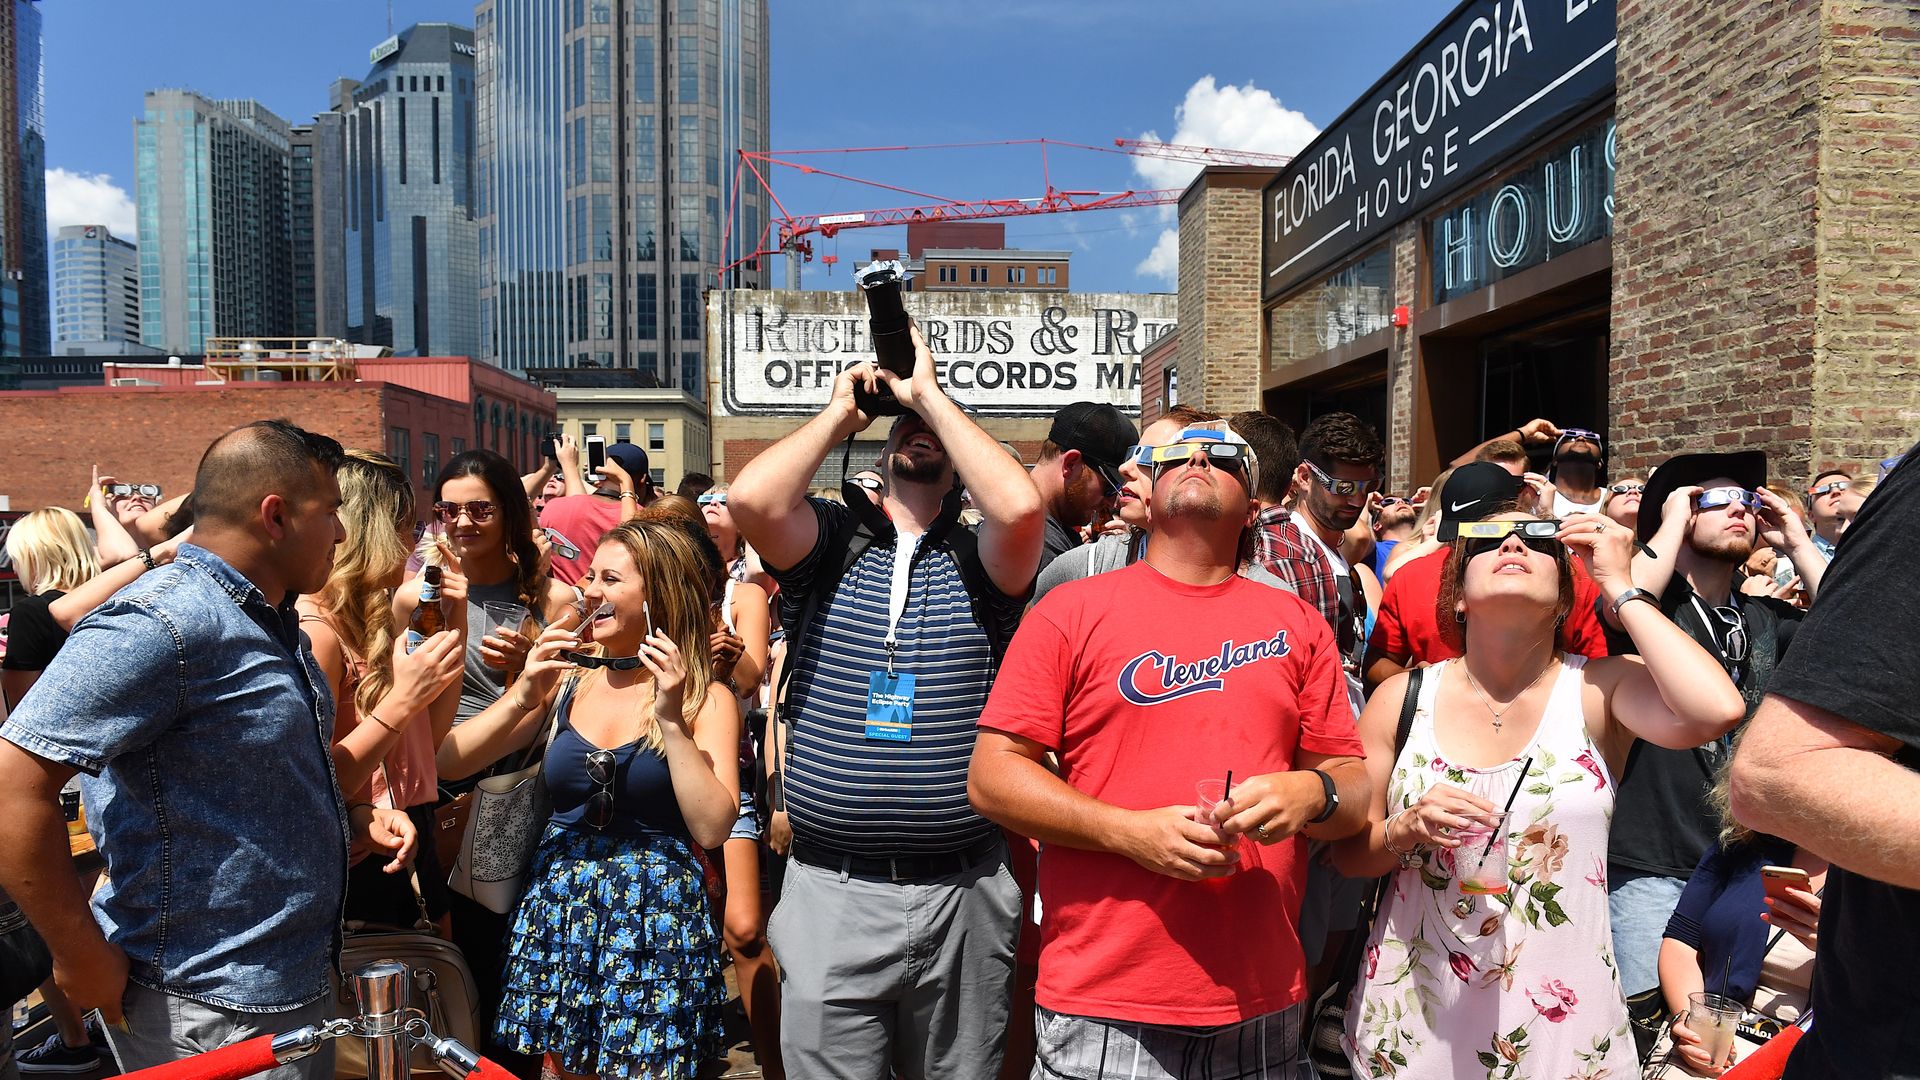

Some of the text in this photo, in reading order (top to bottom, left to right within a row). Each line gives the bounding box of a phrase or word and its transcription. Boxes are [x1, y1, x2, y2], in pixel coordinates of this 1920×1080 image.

[1274, 0, 1534, 243] FLORIDA GEORGIA
[1356, 126, 1460, 232] HOUSE
[1444, 123, 1616, 290] HOU
[743, 305, 1014, 355] RICHRDS
[1030, 306, 1078, 356] &
[764, 359, 880, 389] OFFI
[936, 360, 1077, 390] ECORDS
[893, 700, 910, 708] Party
[1117, 629, 1292, 706] Cleveland
